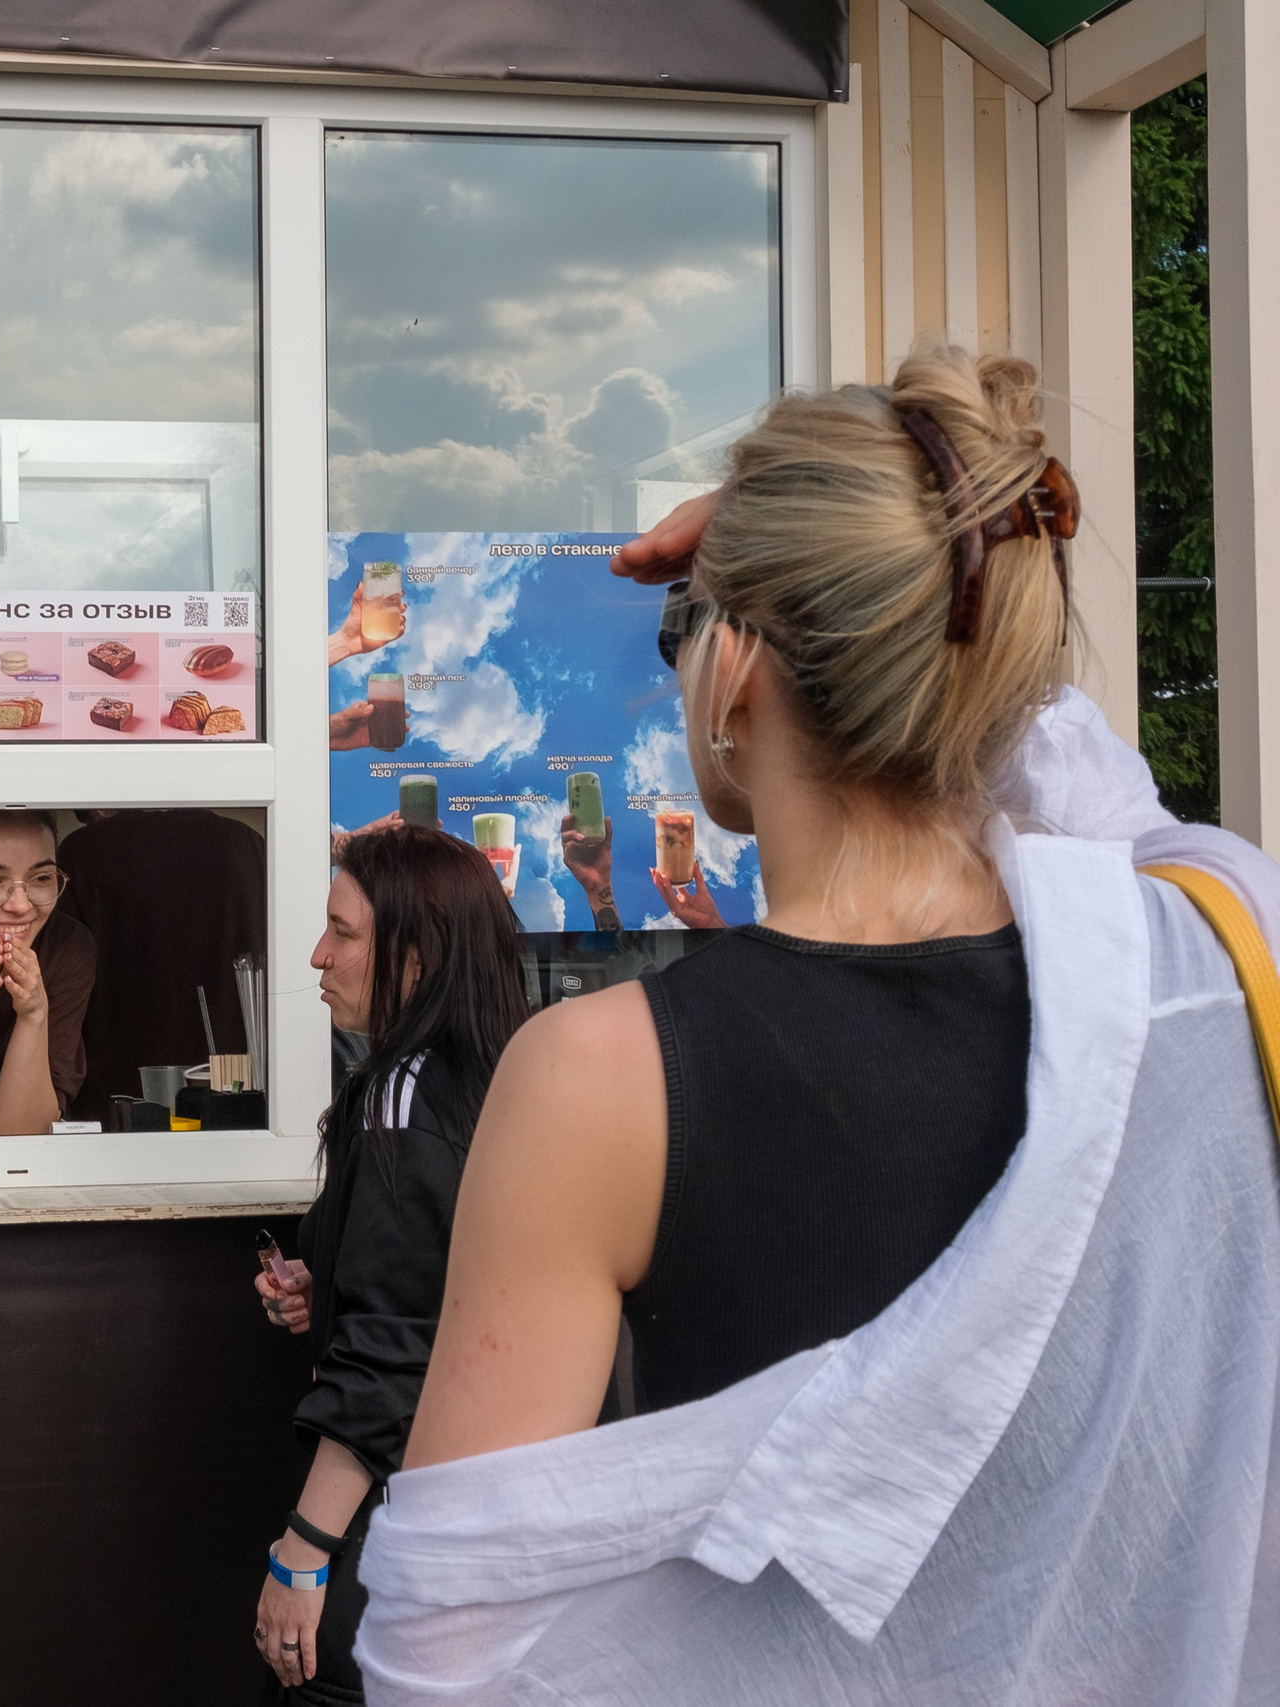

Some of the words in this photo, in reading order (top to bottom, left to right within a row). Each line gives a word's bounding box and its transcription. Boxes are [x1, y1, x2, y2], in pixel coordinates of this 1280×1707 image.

[490, 544, 533, 556] лето
[536, 544, 547, 556] в
[551, 544, 624, 556] стакане
[39, 603, 73, 619] за
[82, 604, 172, 619] отзыв
